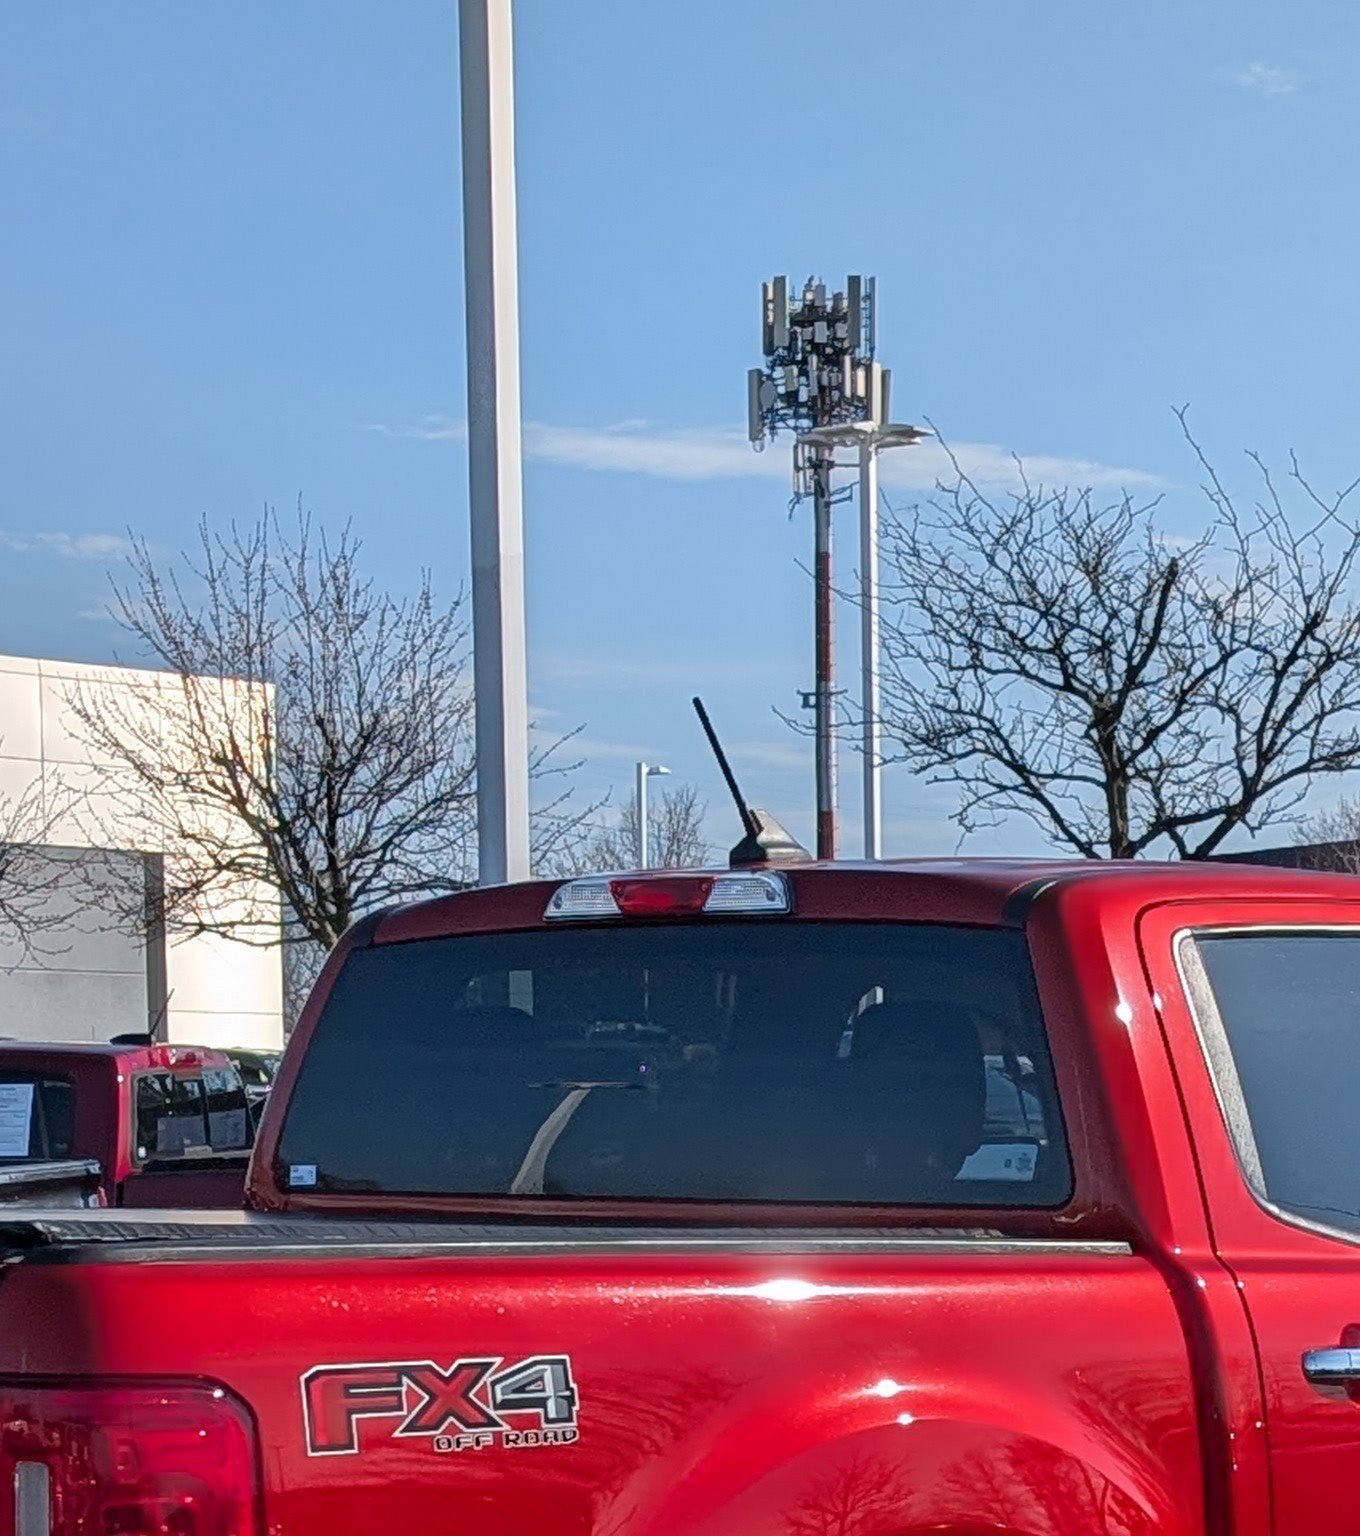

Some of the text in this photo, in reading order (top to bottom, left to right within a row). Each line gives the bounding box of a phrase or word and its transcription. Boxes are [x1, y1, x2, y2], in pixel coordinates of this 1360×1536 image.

[300, 1354, 579, 1457] FX4
[434, 1429, 579, 1453] OFF ROAD
